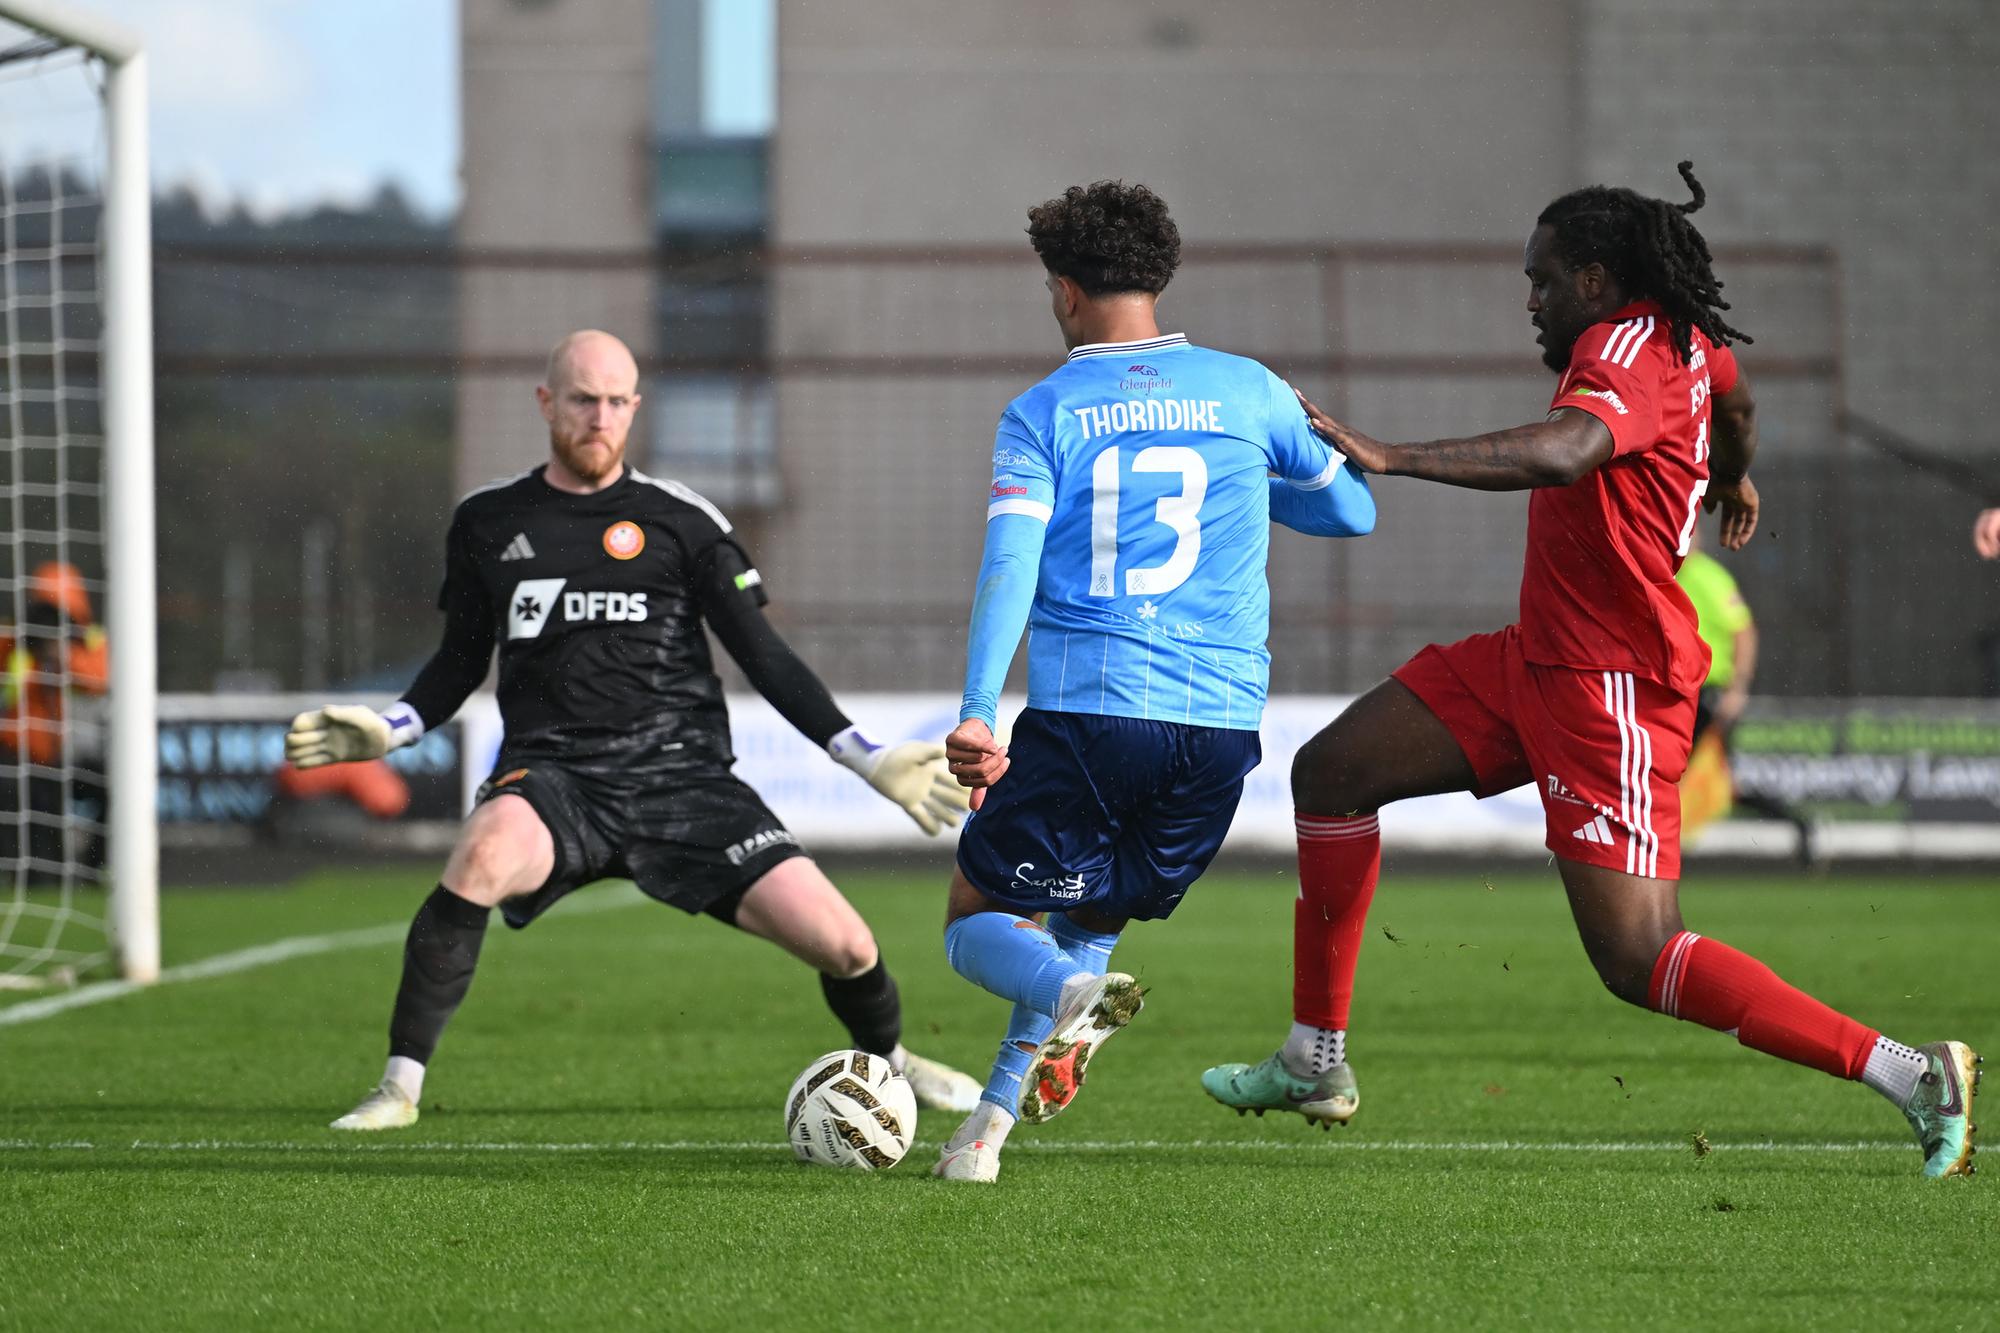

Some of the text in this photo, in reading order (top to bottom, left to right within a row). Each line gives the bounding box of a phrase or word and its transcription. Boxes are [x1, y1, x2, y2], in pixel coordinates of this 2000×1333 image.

[1119, 377, 1172, 394] Glenfield
[1073, 399, 1225, 440] THORNDIKE
[1088, 445, 1208, 598] 13
[563, 591, 649, 622] DFDS
[1049, 887, 1083, 900] bakery
[821, 1118, 840, 1160] uhlsport
